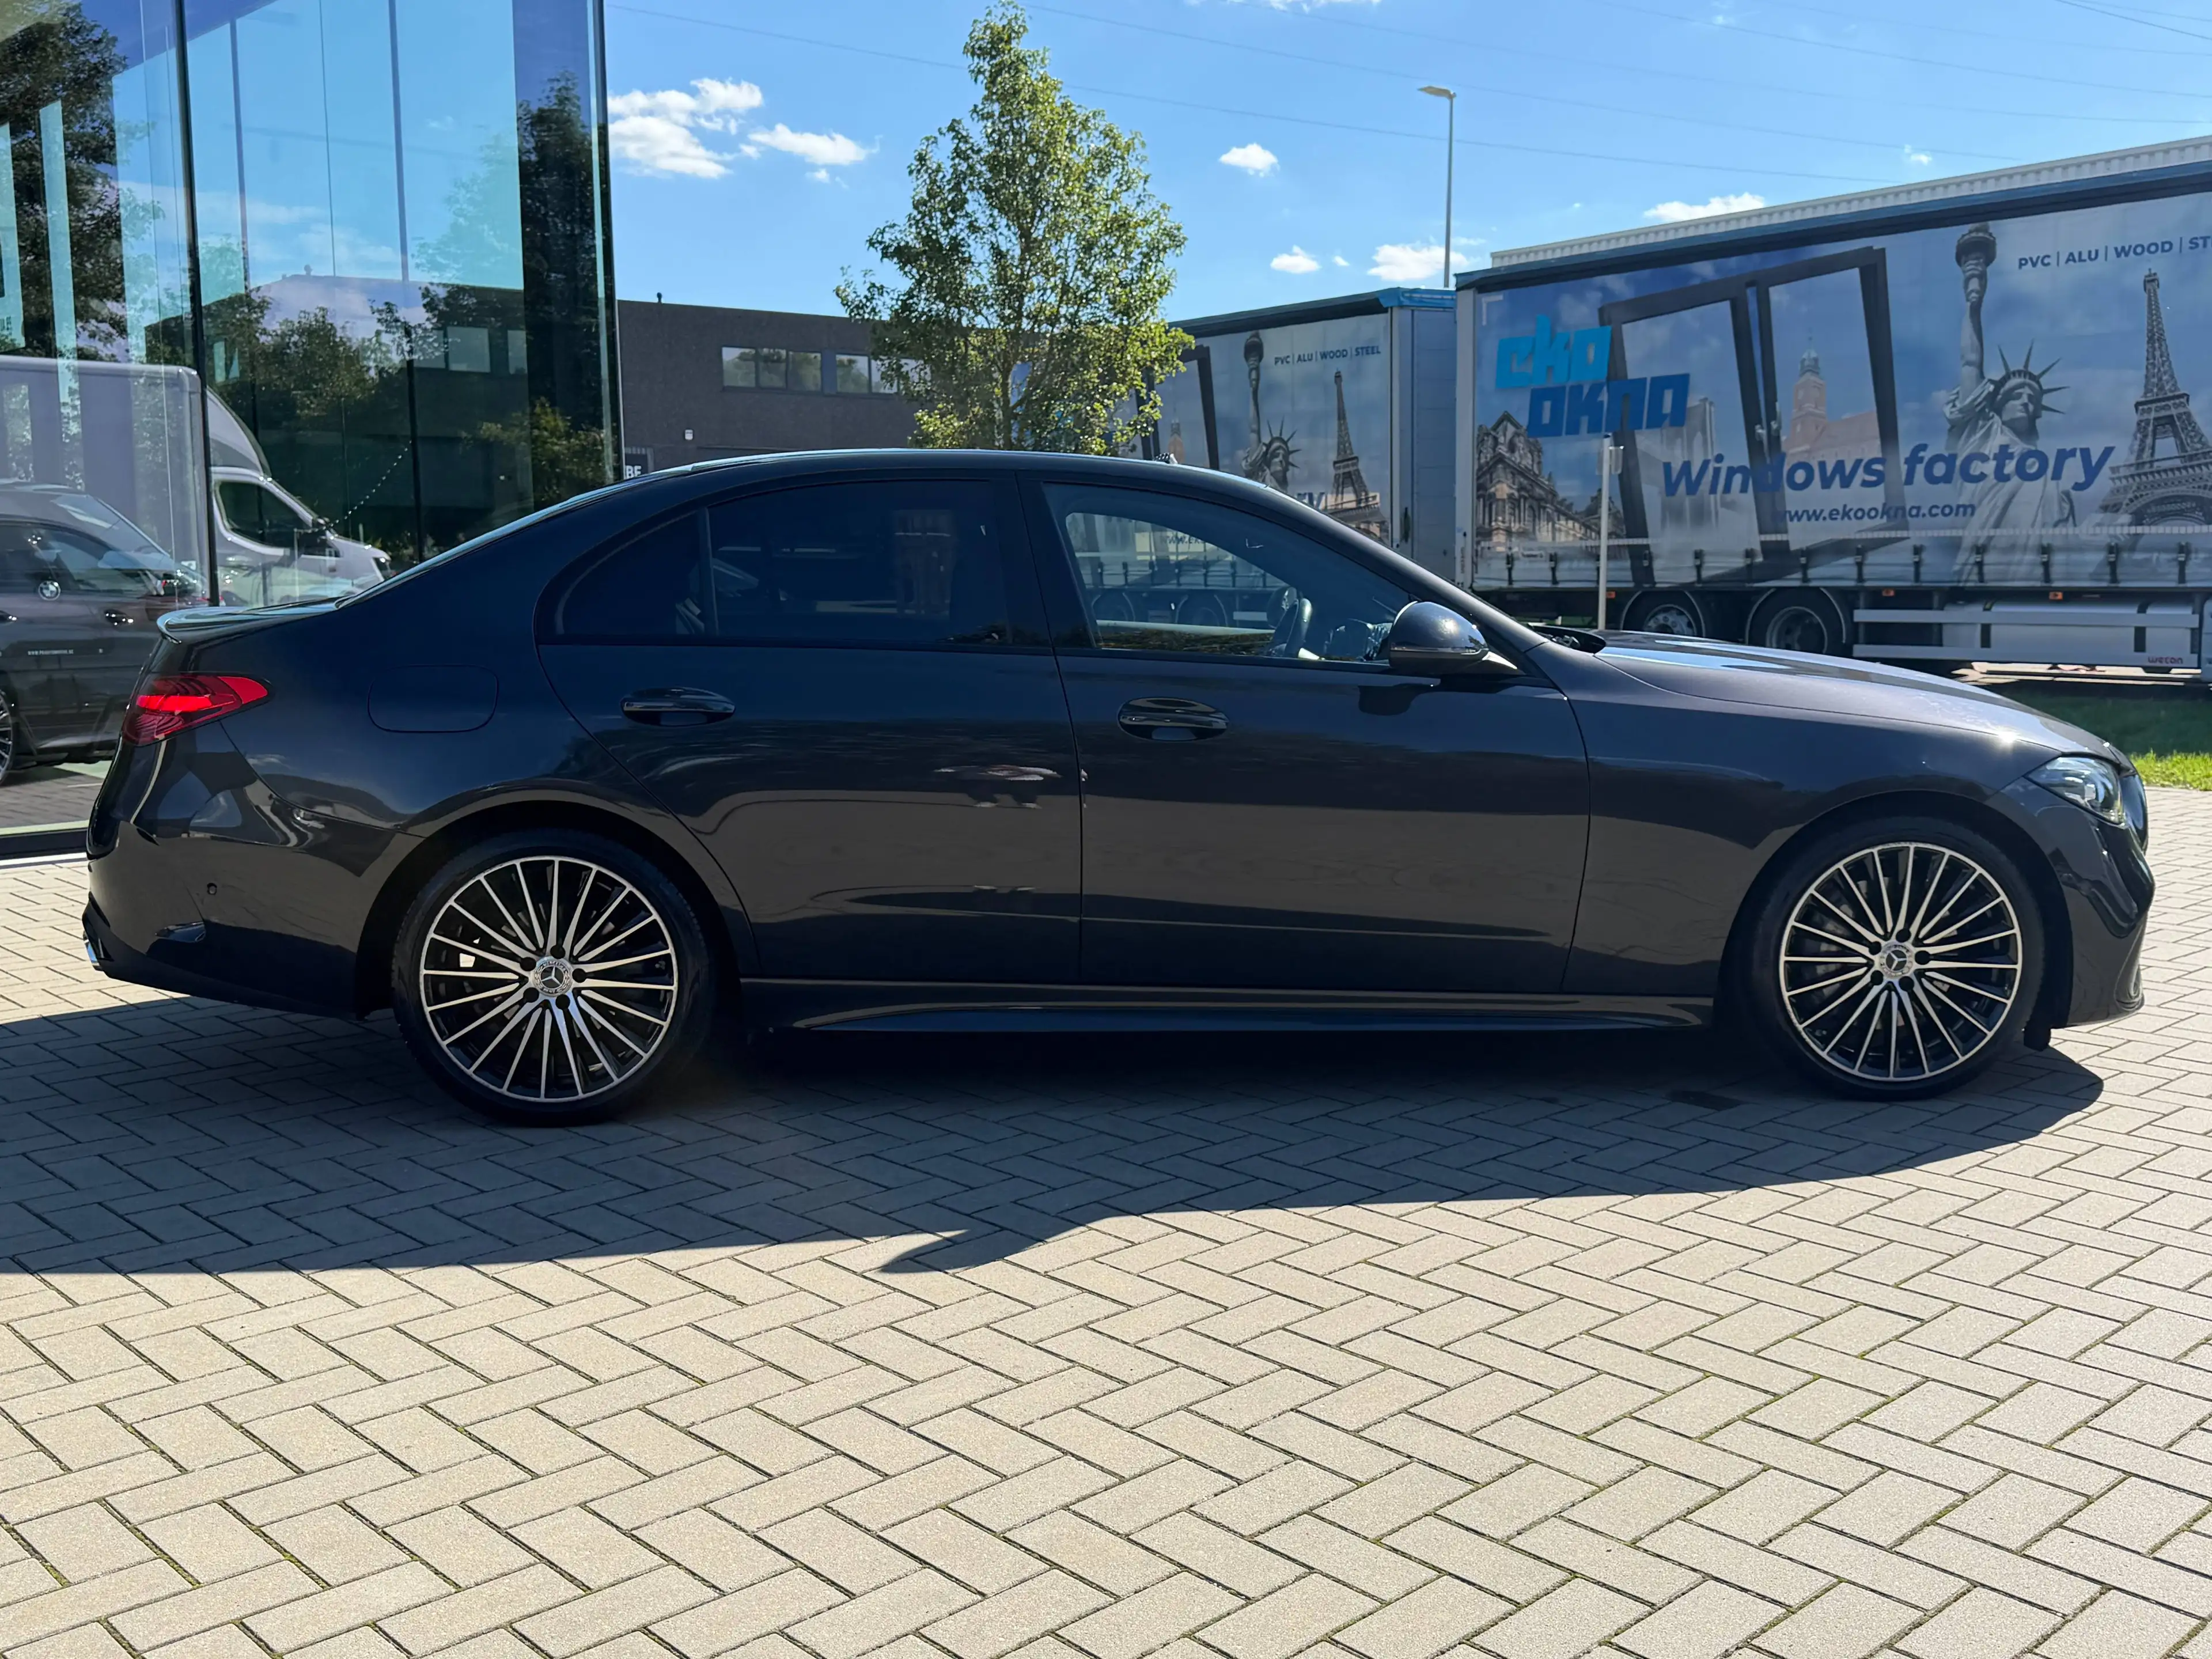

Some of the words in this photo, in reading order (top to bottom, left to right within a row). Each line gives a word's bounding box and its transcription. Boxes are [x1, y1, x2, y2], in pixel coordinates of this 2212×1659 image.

[2018, 254, 2051, 270] PVC
[2065, 249, 2099, 264] ALU
[2113, 240, 2173, 259] WOOD
[2188, 236, 2212, 250] ST
[1274, 355, 1290, 366] PVC
[1297, 353, 1313, 363] ALU
[1319, 349, 1348, 360] WOOD
[1355, 345, 1381, 357] STEEL
[1662, 451, 1887, 498] Windows
[1903, 443, 2116, 493] factory
[1771, 502, 1977, 523] www.ekookna.com
